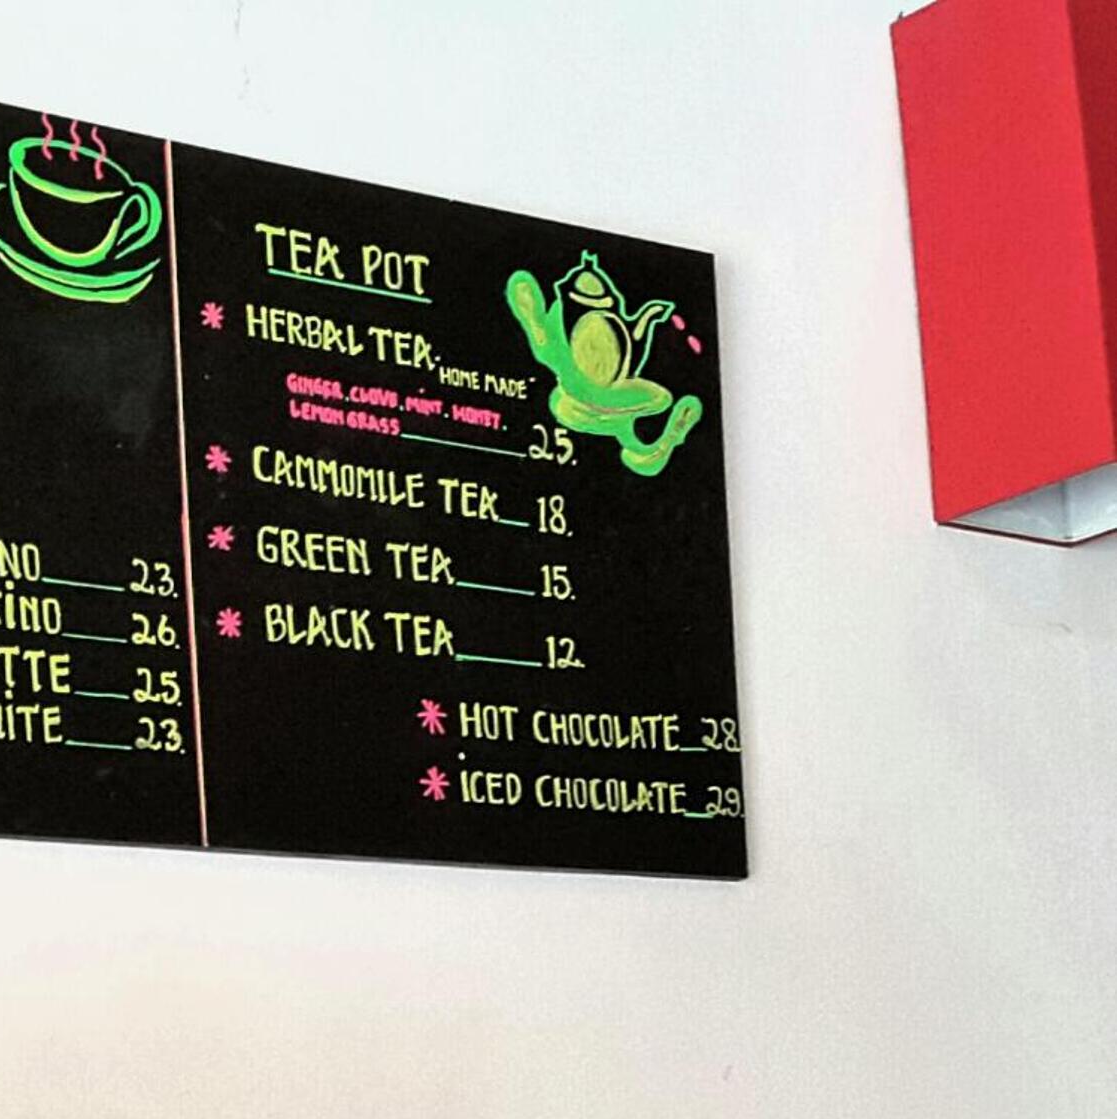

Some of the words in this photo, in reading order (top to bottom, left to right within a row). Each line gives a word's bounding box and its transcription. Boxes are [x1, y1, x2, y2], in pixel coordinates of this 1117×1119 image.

[255, 223, 344, 279] TEA
[362, 245, 429, 295] POT
[246, 304, 363, 355] HERBAL
[439, 367, 480, 389] HOME
[485, 374, 526, 399] MADE
[344, 411, 400, 435] GRASS
[253, 446, 424, 507] CAMMOMILE
[438, 479, 499, 521] TEA
[257, 526, 371, 575] GREEN
[386, 543, 454, 584] TEA
[265, 604, 374, 650] BLACK
[384, 612, 454, 655] TEA
[460, 702, 518, 740] HOT
[533, 711, 679, 751] CHOCOLATE
[535, 775, 686, 816] CHOCOLATE
